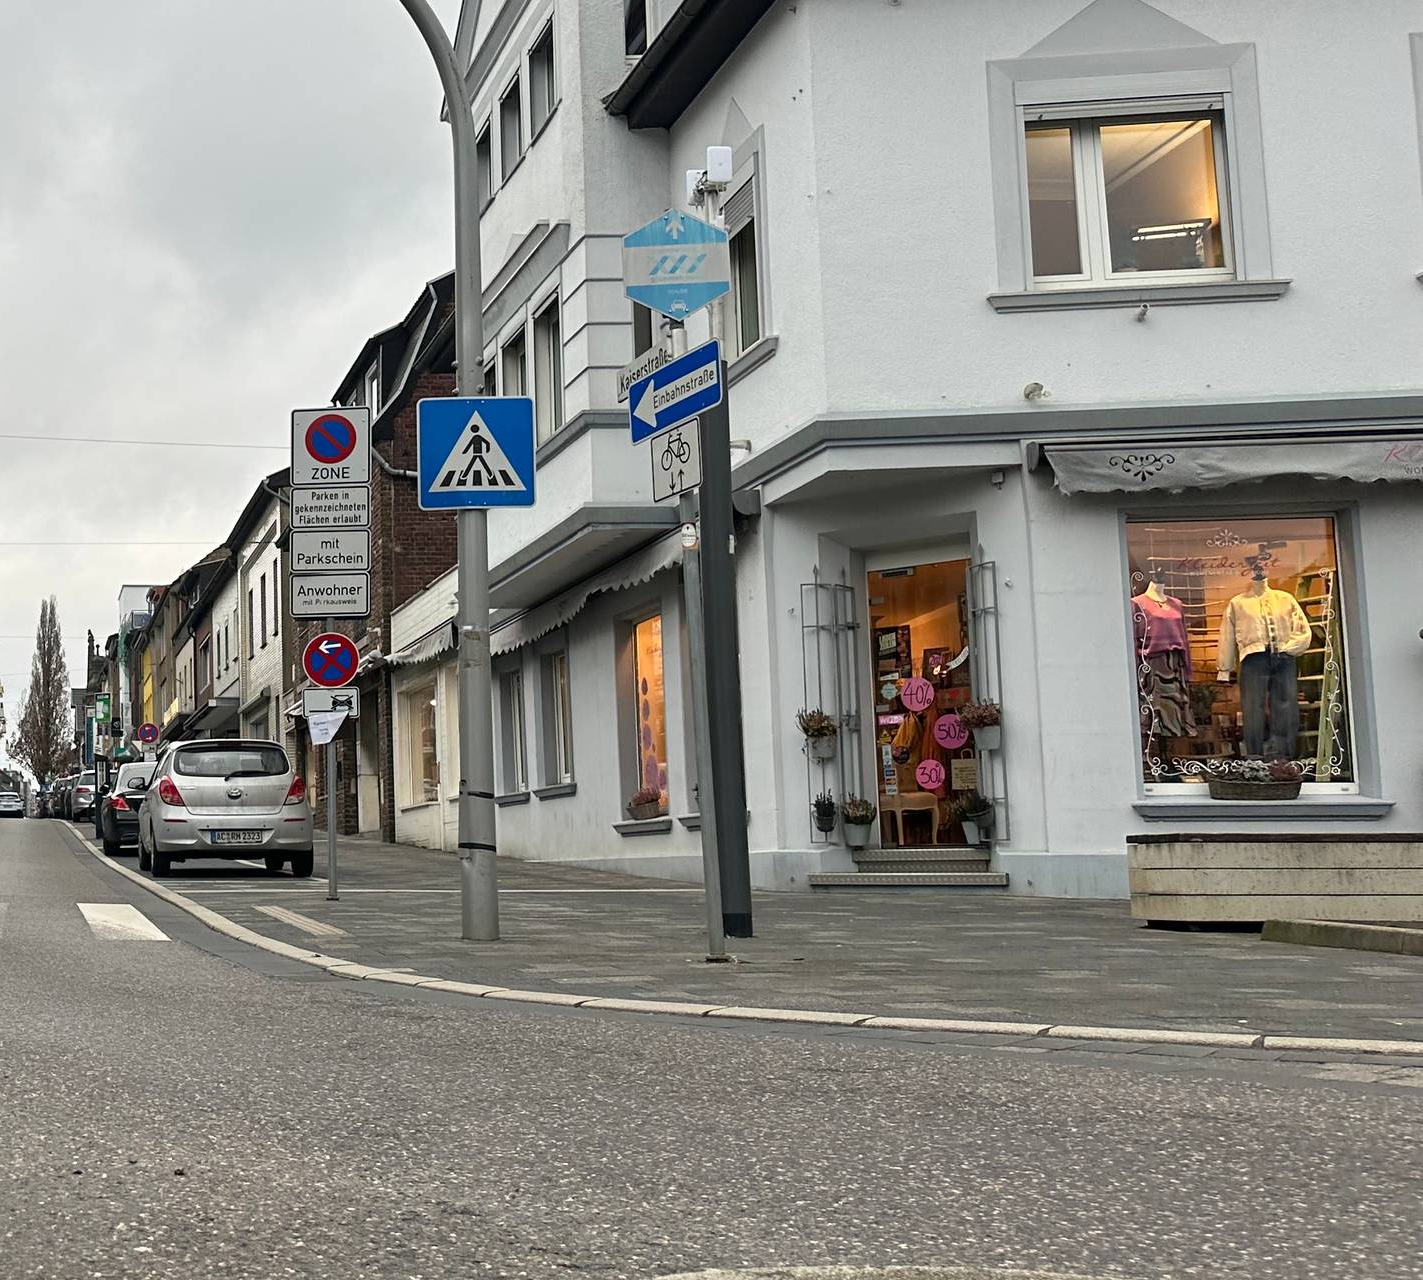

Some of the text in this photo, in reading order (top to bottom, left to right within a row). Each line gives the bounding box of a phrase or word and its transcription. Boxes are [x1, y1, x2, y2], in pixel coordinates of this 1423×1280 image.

[653, 369, 715, 409] Einbahnstraße
[311, 466, 350, 480] ZONE
[311, 491, 350, 501] Parken in
[294, 503, 367, 514] gekennzeichneten
[299, 514, 362, 524] Flächen erlaubt
[320, 538, 340, 550] mit
[297, 552, 364, 565] Parkschein
[297, 584, 363, 597] Anwohner
[903, 682, 932, 706] 40%
[919, 762, 942, 784] 30%
[242, 832, 261, 840] 2323
